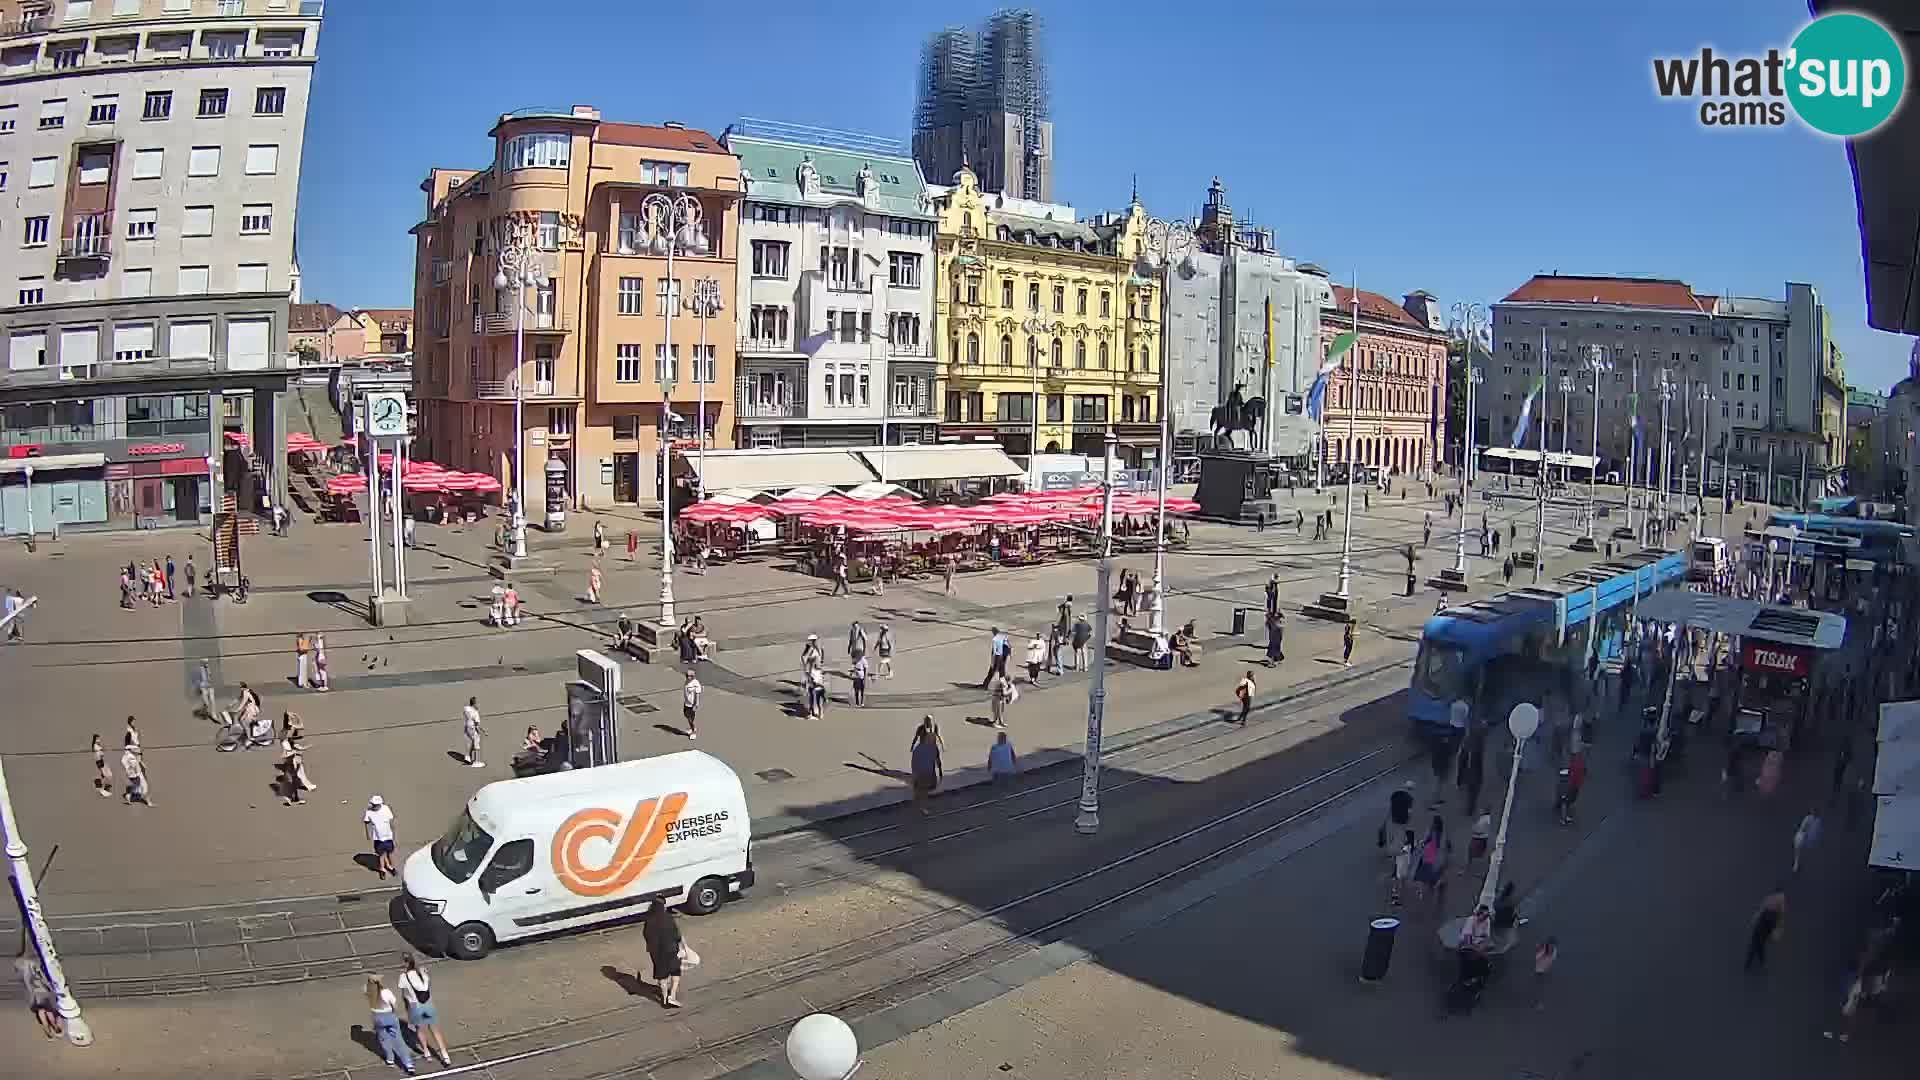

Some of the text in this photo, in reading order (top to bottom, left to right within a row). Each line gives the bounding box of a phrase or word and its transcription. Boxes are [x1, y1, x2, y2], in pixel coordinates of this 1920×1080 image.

[1754, 648, 1798, 671] TISAK
[665, 810, 729, 833] OVERSEAS
[666, 823, 722, 844] EXPRESS
